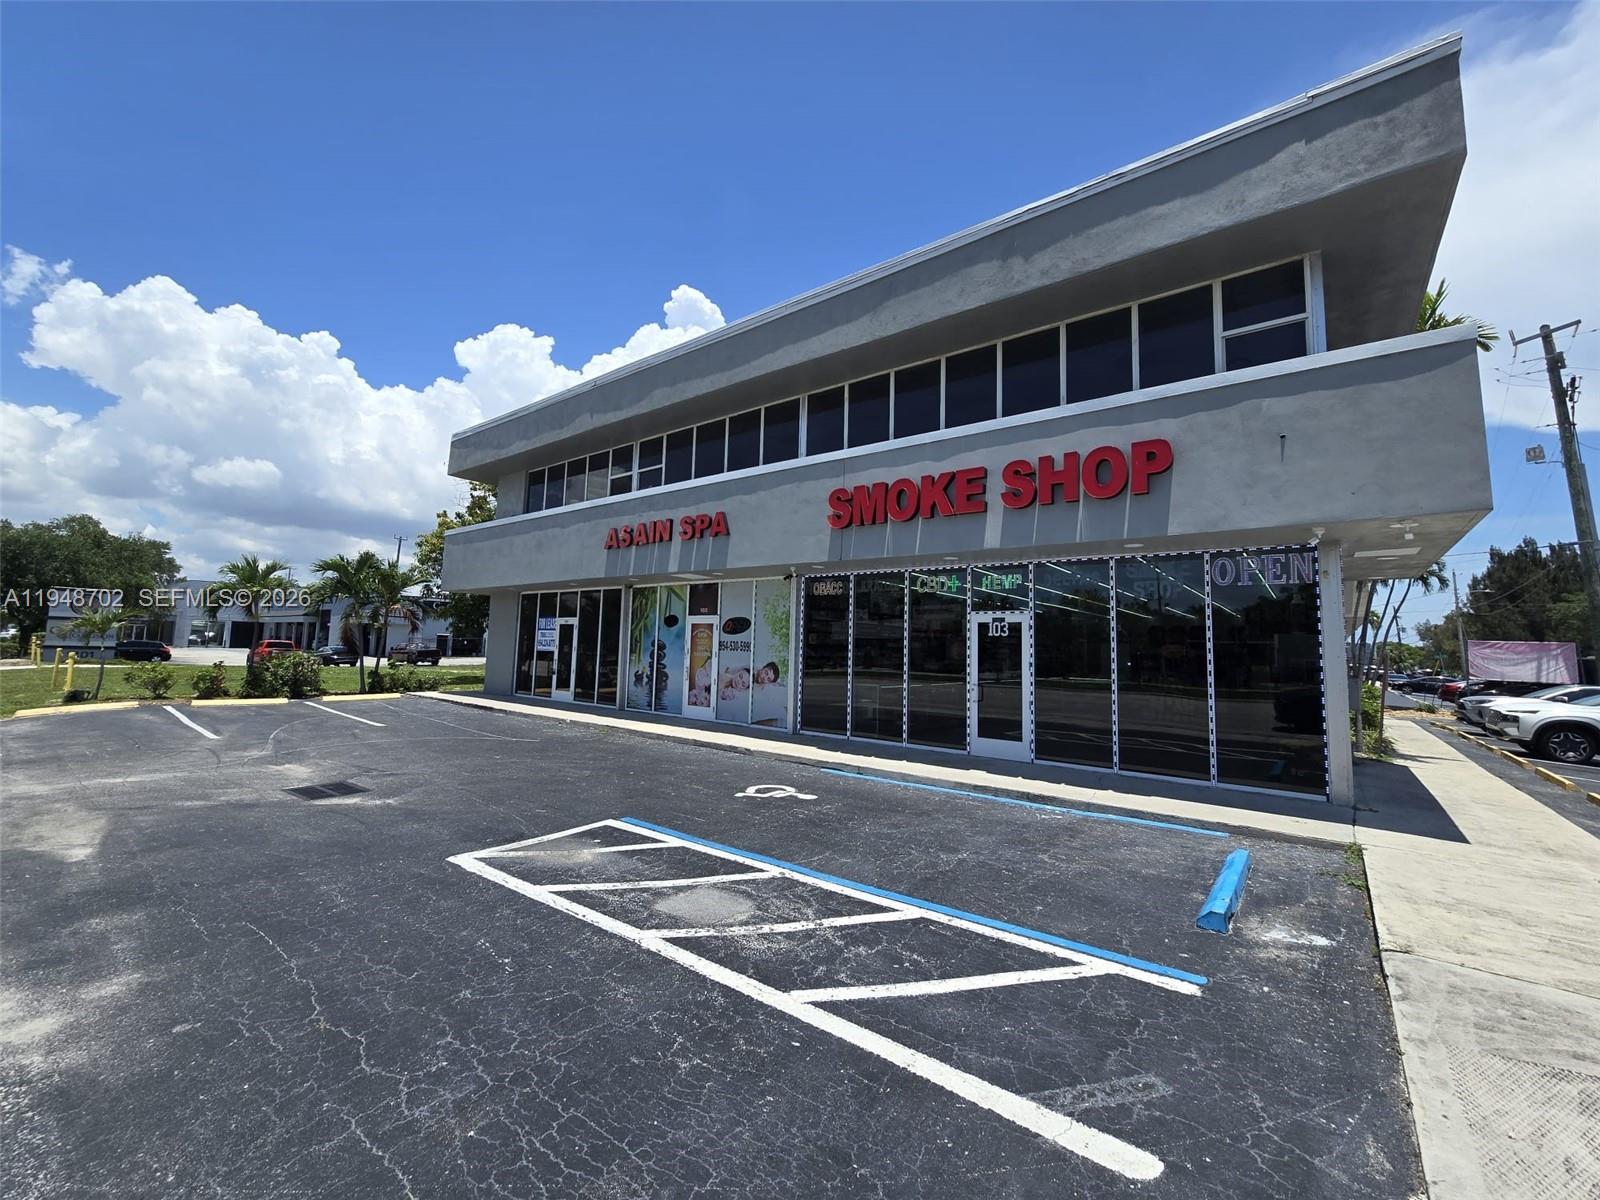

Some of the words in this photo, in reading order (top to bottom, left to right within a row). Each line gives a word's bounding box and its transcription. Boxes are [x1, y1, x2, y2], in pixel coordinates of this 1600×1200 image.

[827, 466, 988, 529] SMOKE
[1000, 438, 1174, 509] SHOP
[604, 518, 673, 549] ASAIN
[679, 511, 730, 541] SPA
[982, 574, 1022, 590] HEMP
[1212, 552, 1314, 586] OPEN
[988, 622, 1009, 637] 103
